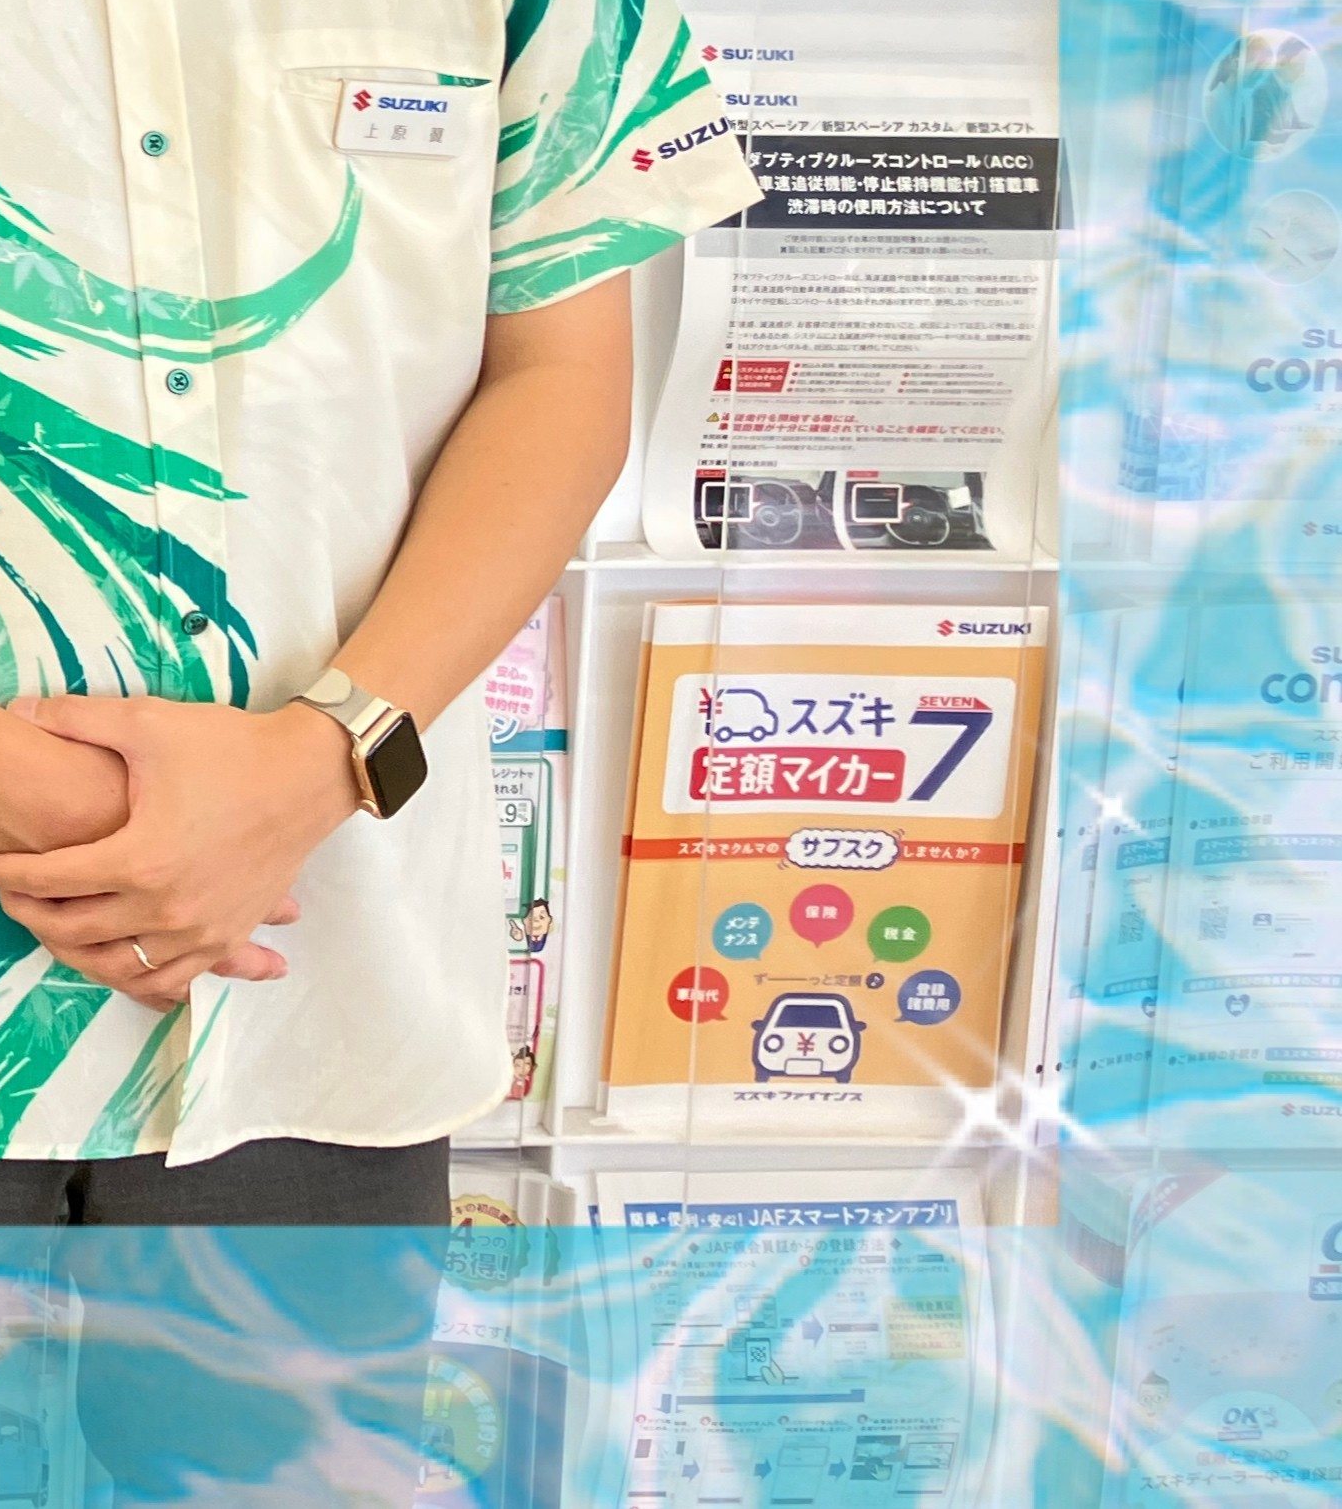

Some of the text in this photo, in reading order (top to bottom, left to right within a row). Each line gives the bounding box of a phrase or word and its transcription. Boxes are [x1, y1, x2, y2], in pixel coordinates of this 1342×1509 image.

[377, 96, 449, 114] SUZUKI
[725, 93, 799, 107] SUZUKI
[787, 198, 987, 216] 渋滞時の使用方法について
[958, 621, 1032, 636] SUZUKI
[918, 695, 976, 709] SEVEN
[786, 692, 896, 738] スズキ
[906, 709, 994, 802] 7
[697, 752, 896, 798] 定額マイカー
[677, 837, 981, 860] スズキでクルマの サブスク しませんか？
[724, 915, 761, 930] メンテ
[804, 904, 918, 942] 保険 税金
[733, 1090, 864, 1103] スズキファイナンス
[748, 1203, 954, 1227] JAFスマートフォンアプリ
